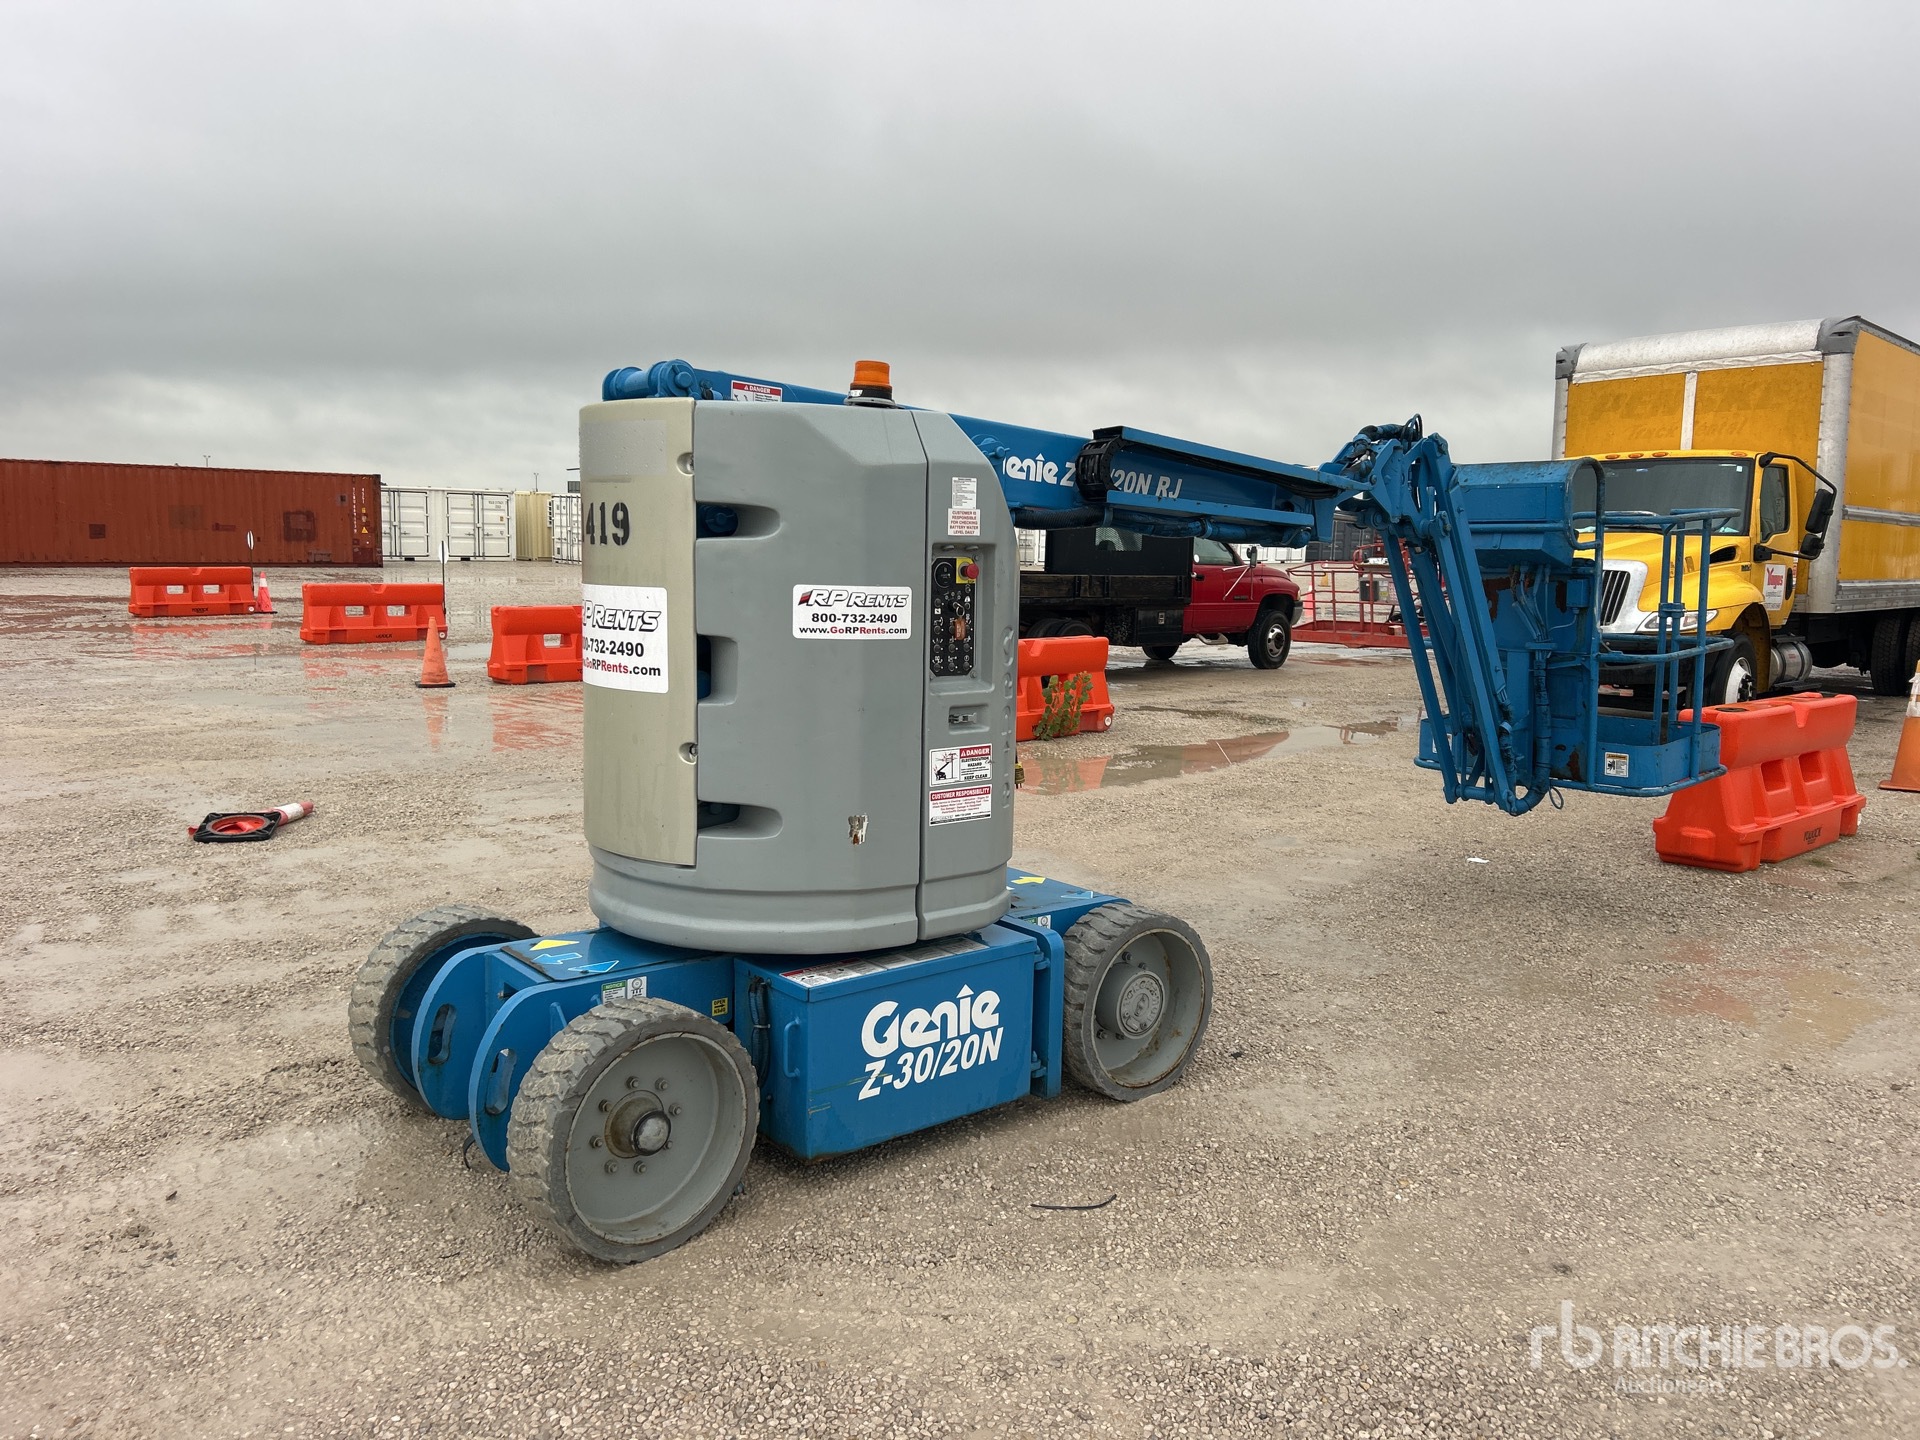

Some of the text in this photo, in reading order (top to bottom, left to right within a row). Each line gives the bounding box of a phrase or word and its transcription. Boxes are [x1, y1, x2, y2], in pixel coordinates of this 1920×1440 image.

[749, 385, 771, 394] DANGER
[1002, 453, 1058, 486] enie
[1155, 476, 1183, 499] RJ
[581, 501, 631, 546] 419
[806, 588, 909, 608] RP RENTS
[583, 598, 662, 633] P RENTS
[811, 612, 898, 624] 800-732-2490
[799, 625, 908, 635] www.GoRPRents.com
[966, 747, 990, 756] DANGER
[931, 787, 990, 799] CUSTOMER RESPONSIBILITY
[861, 984, 1001, 1058] Genie
[858, 1027, 1004, 1101] Z-30/20N
